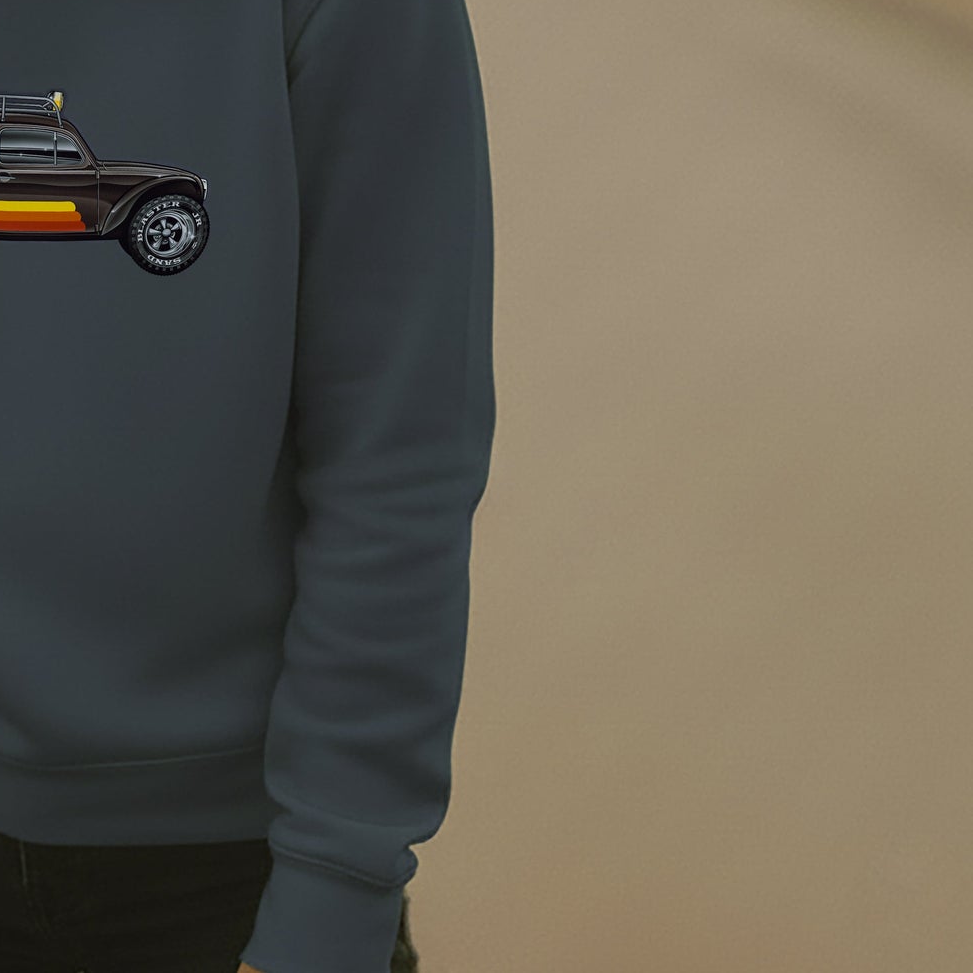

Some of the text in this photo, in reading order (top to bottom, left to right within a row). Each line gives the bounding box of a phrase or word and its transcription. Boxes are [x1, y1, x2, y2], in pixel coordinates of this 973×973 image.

[137, 201, 202, 266] SAND BLASTER JR
